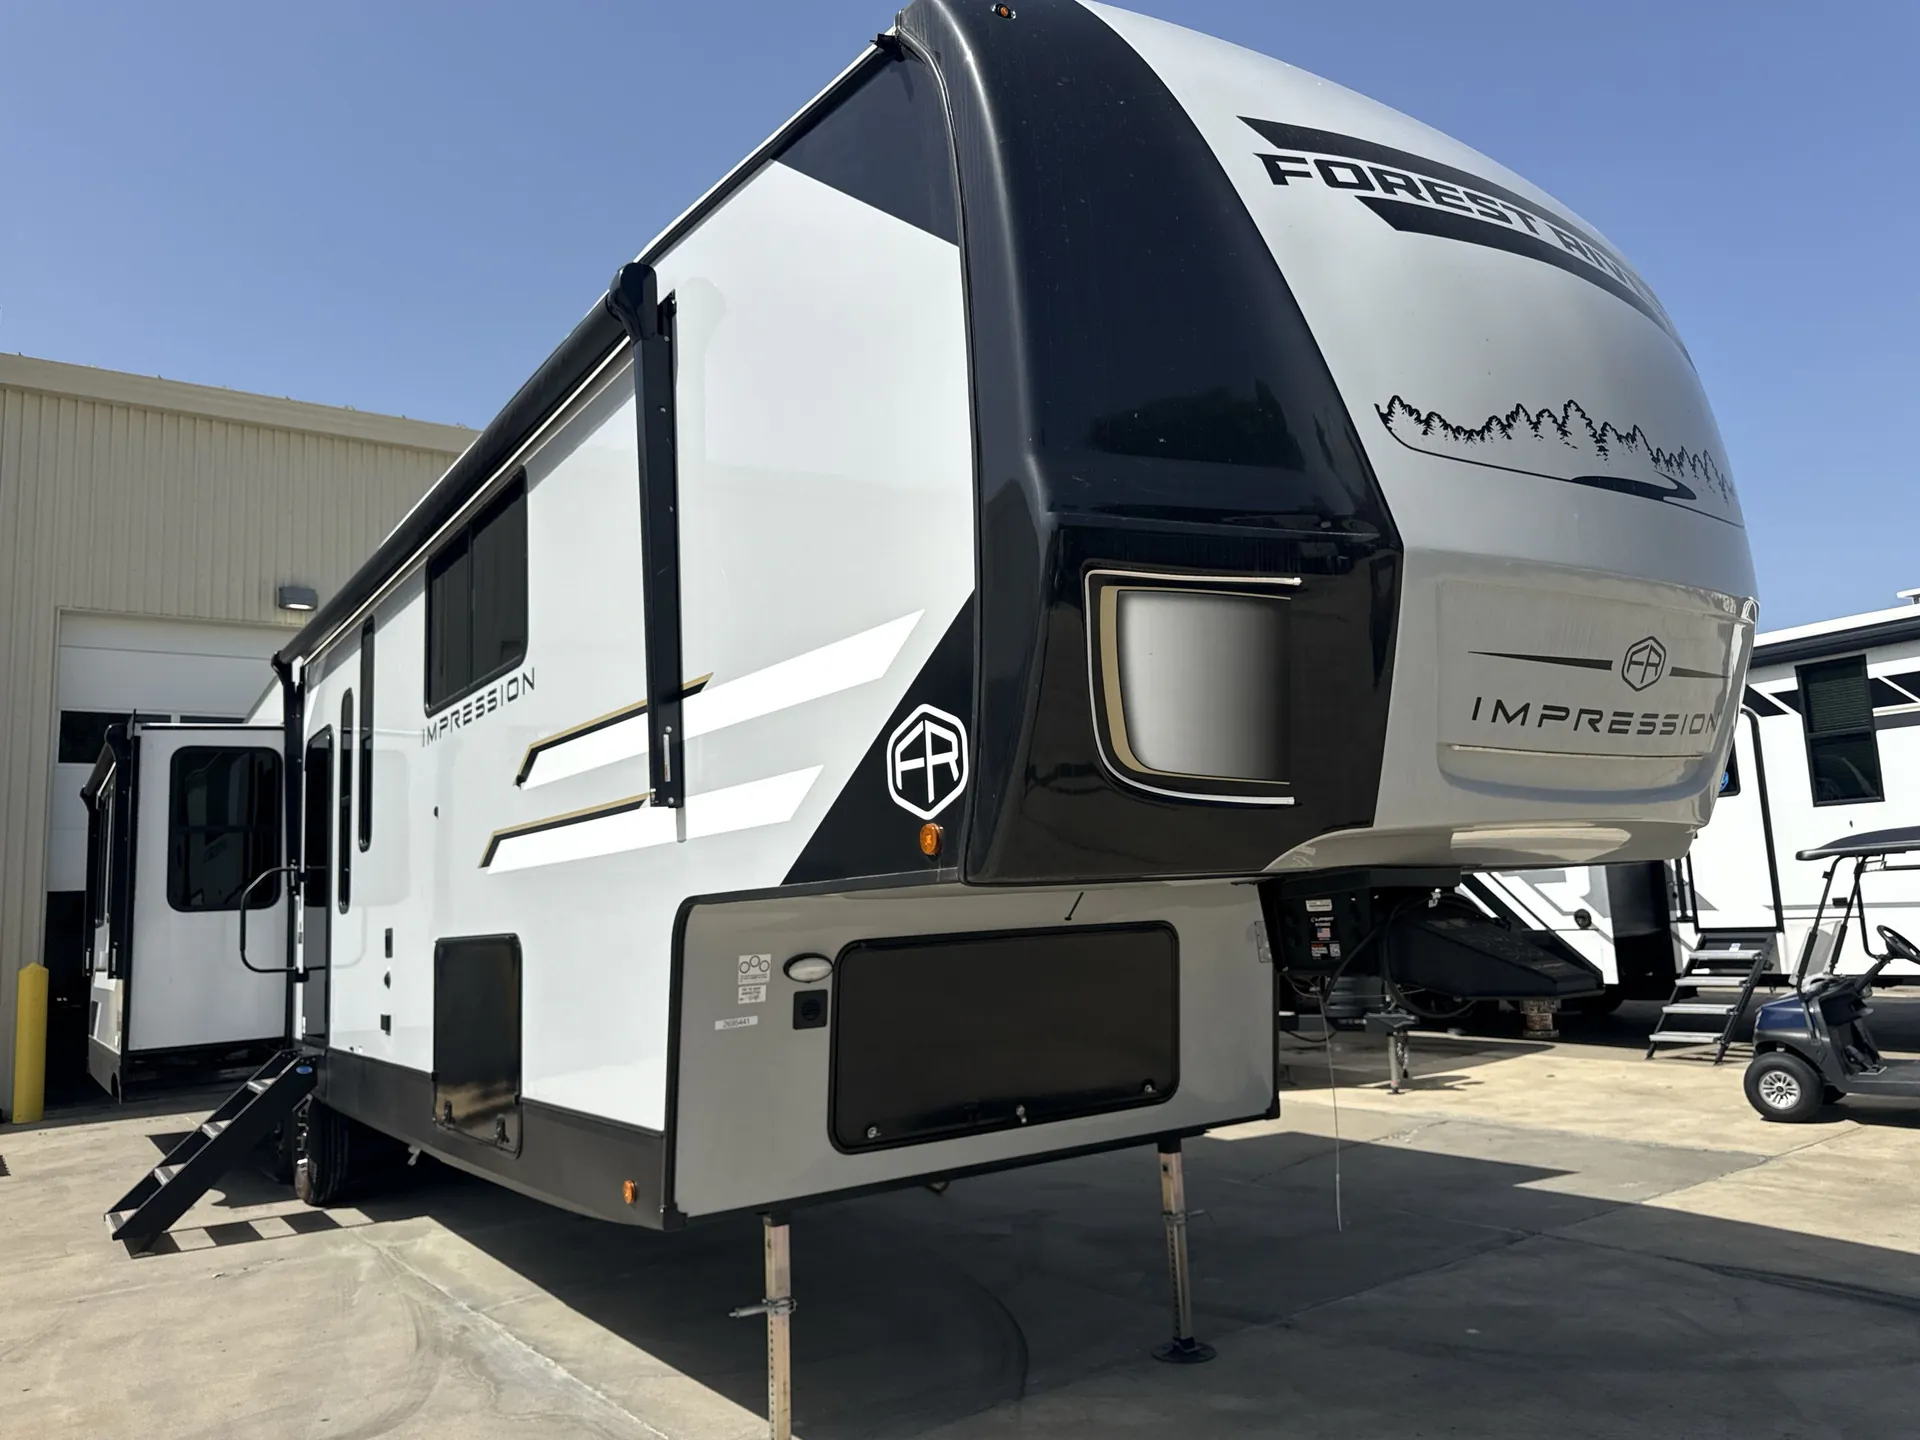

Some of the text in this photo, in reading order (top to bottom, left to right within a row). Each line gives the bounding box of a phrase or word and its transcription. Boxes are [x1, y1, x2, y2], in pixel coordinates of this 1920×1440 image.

[1253, 152, 1540, 236] FOREST
[422, 667, 535, 748] IMPRESSION
[1471, 696, 1722, 736] IMPRESSION
